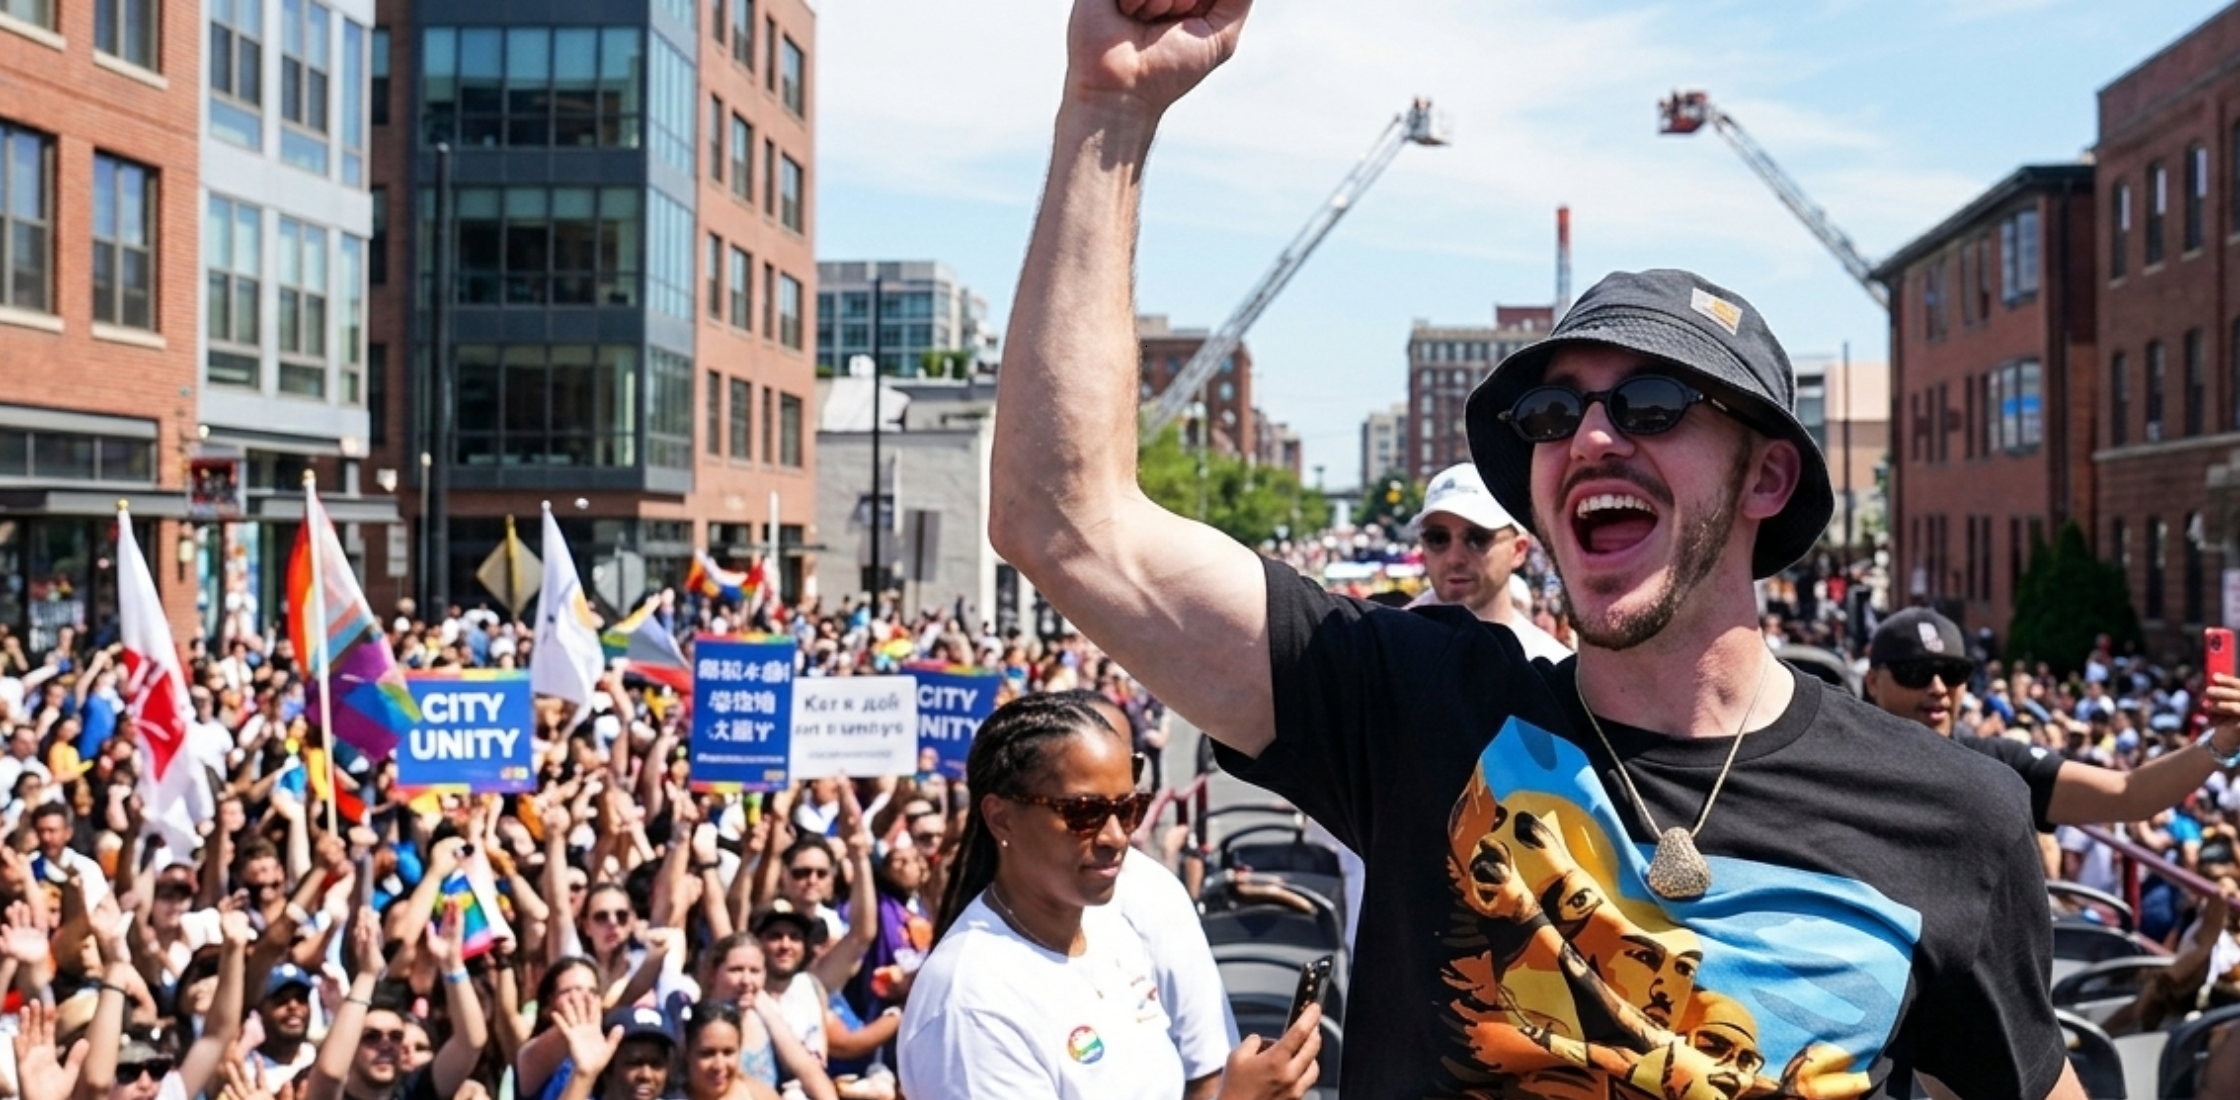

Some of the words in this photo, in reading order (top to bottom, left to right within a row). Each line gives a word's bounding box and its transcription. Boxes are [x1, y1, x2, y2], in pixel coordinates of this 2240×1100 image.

[421, 692, 505, 724] CITY
[918, 684, 978, 712] CITY
[918, 714, 986, 741] NITY
[409, 728, 520, 761] UNITY
